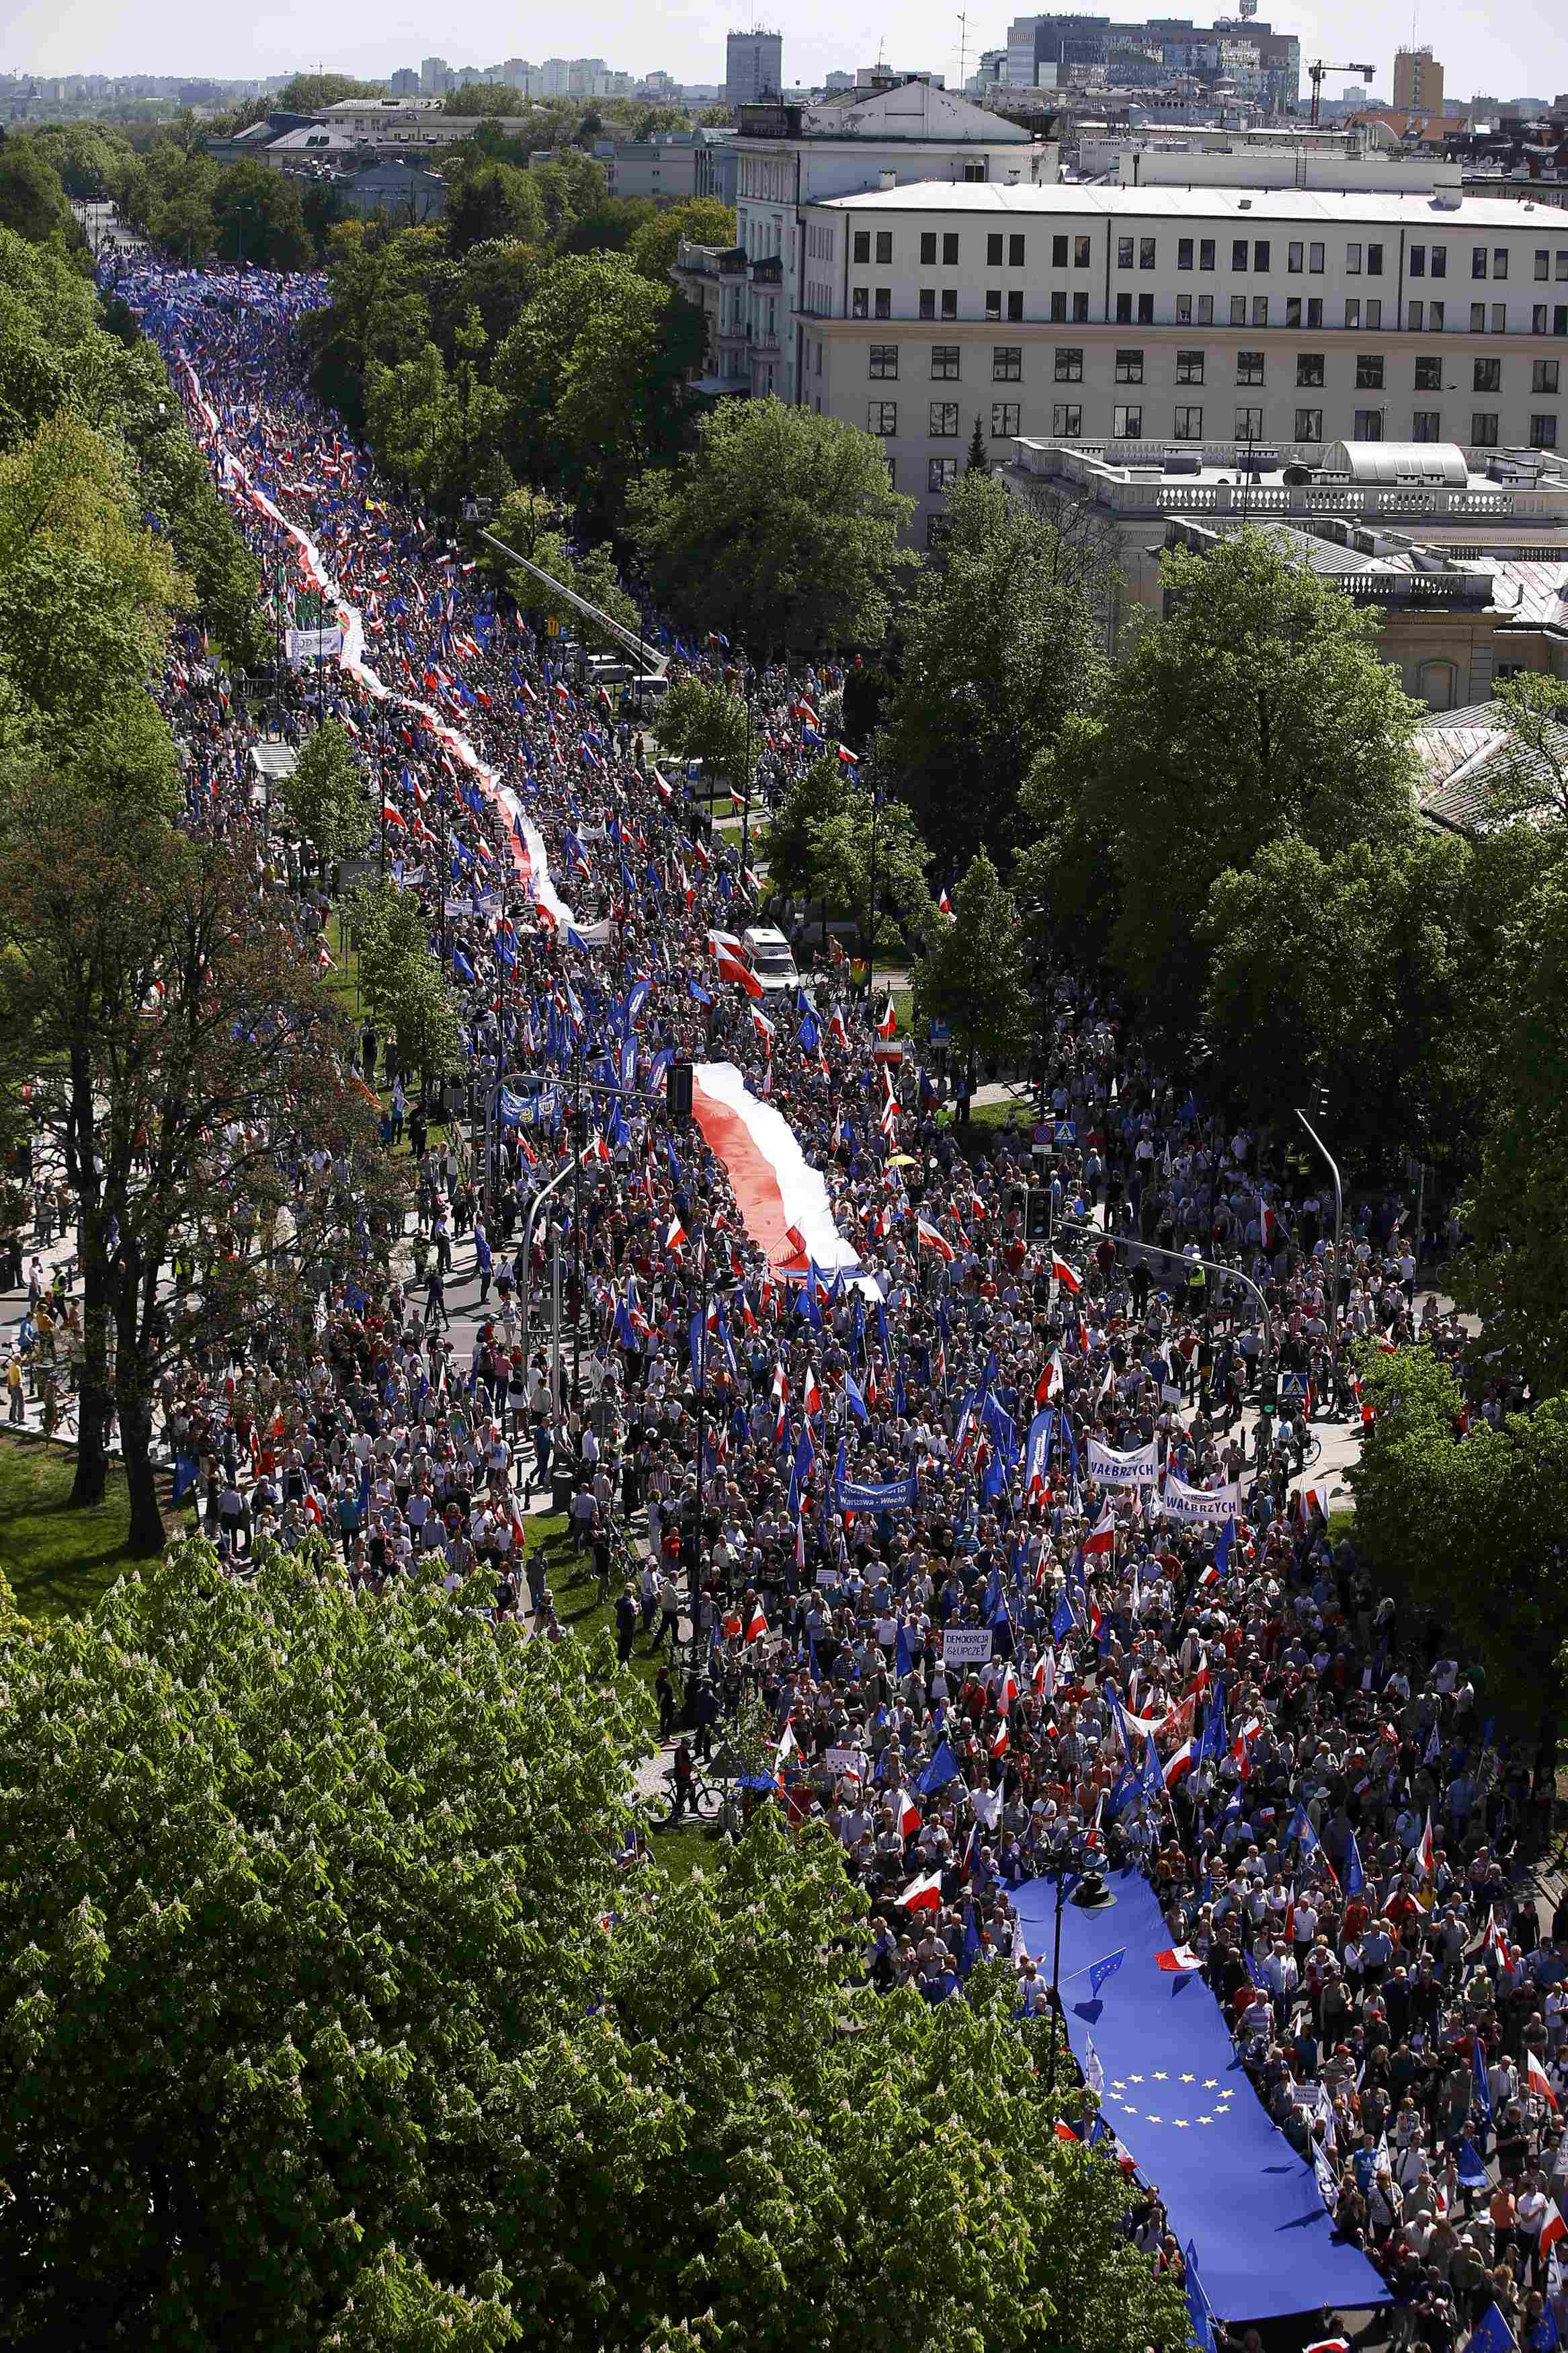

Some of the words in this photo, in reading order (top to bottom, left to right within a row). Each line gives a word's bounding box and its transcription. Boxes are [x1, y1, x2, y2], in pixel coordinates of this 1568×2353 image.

[839, 1495, 874, 1506] Warszawa
[1167, 1496, 1235, 1513] WAŁBRZYCH
[946, 1634, 989, 1644] DEMOKRACJA
